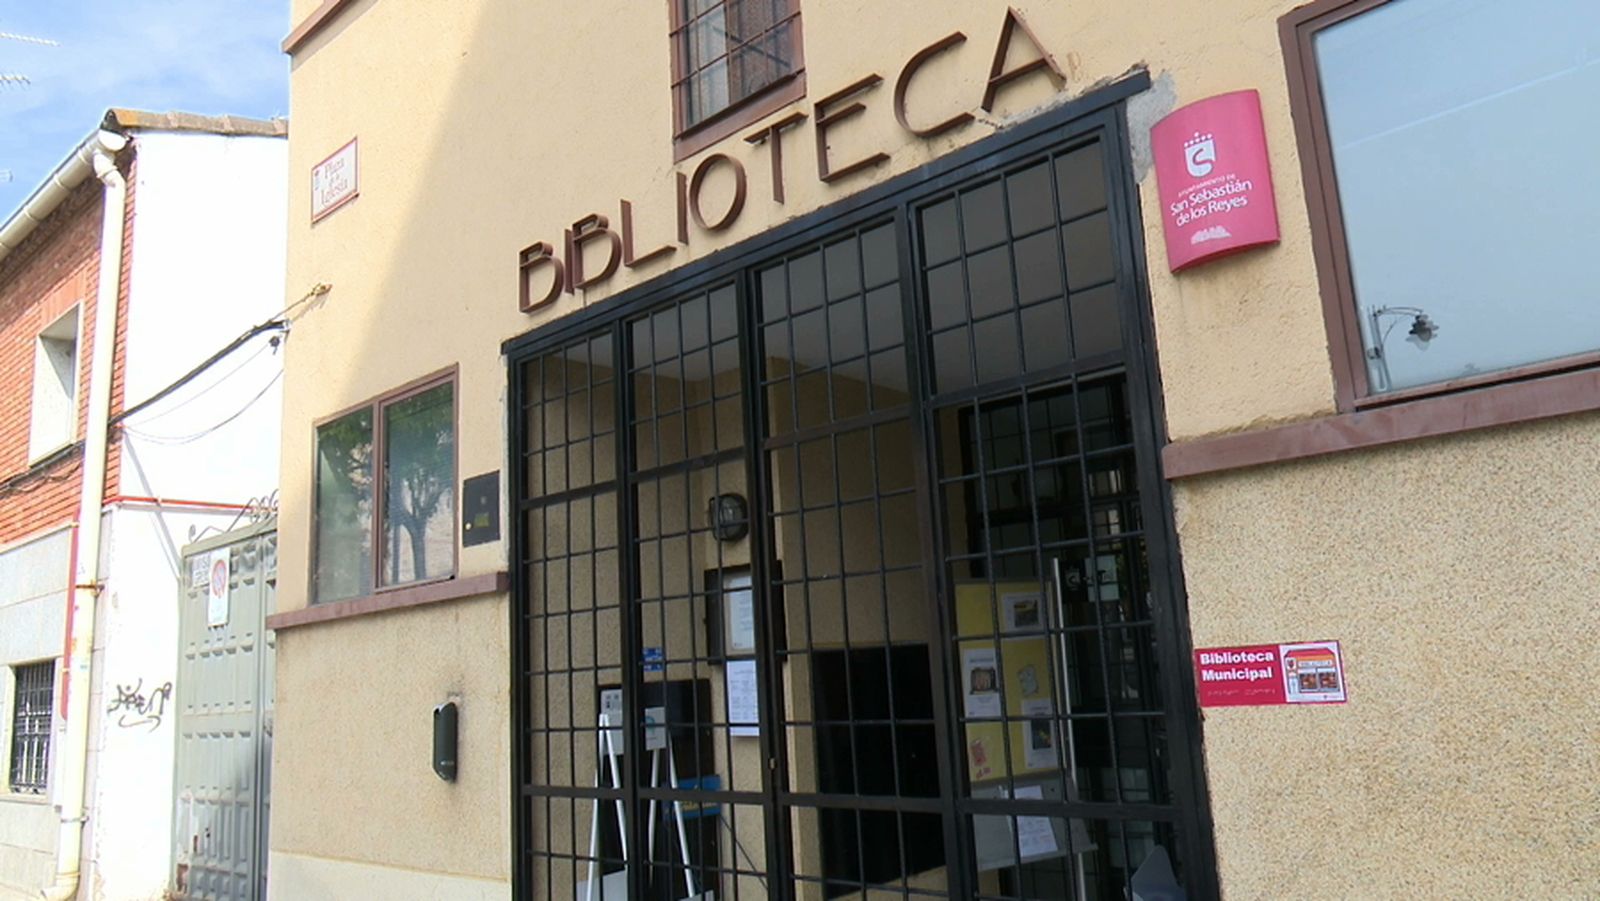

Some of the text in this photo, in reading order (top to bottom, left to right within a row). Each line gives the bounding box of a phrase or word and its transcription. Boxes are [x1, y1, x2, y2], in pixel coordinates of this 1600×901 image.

[324, 158, 345, 179] Plaza
[518, 6, 1067, 315] BIBLIOTECA
[1170, 178, 1252, 216] San Sebastián
[1176, 195, 1248, 228] de los Reyes
[1199, 652, 1274, 666] Biblioteca
[1201, 666, 1274, 682] Municipal
